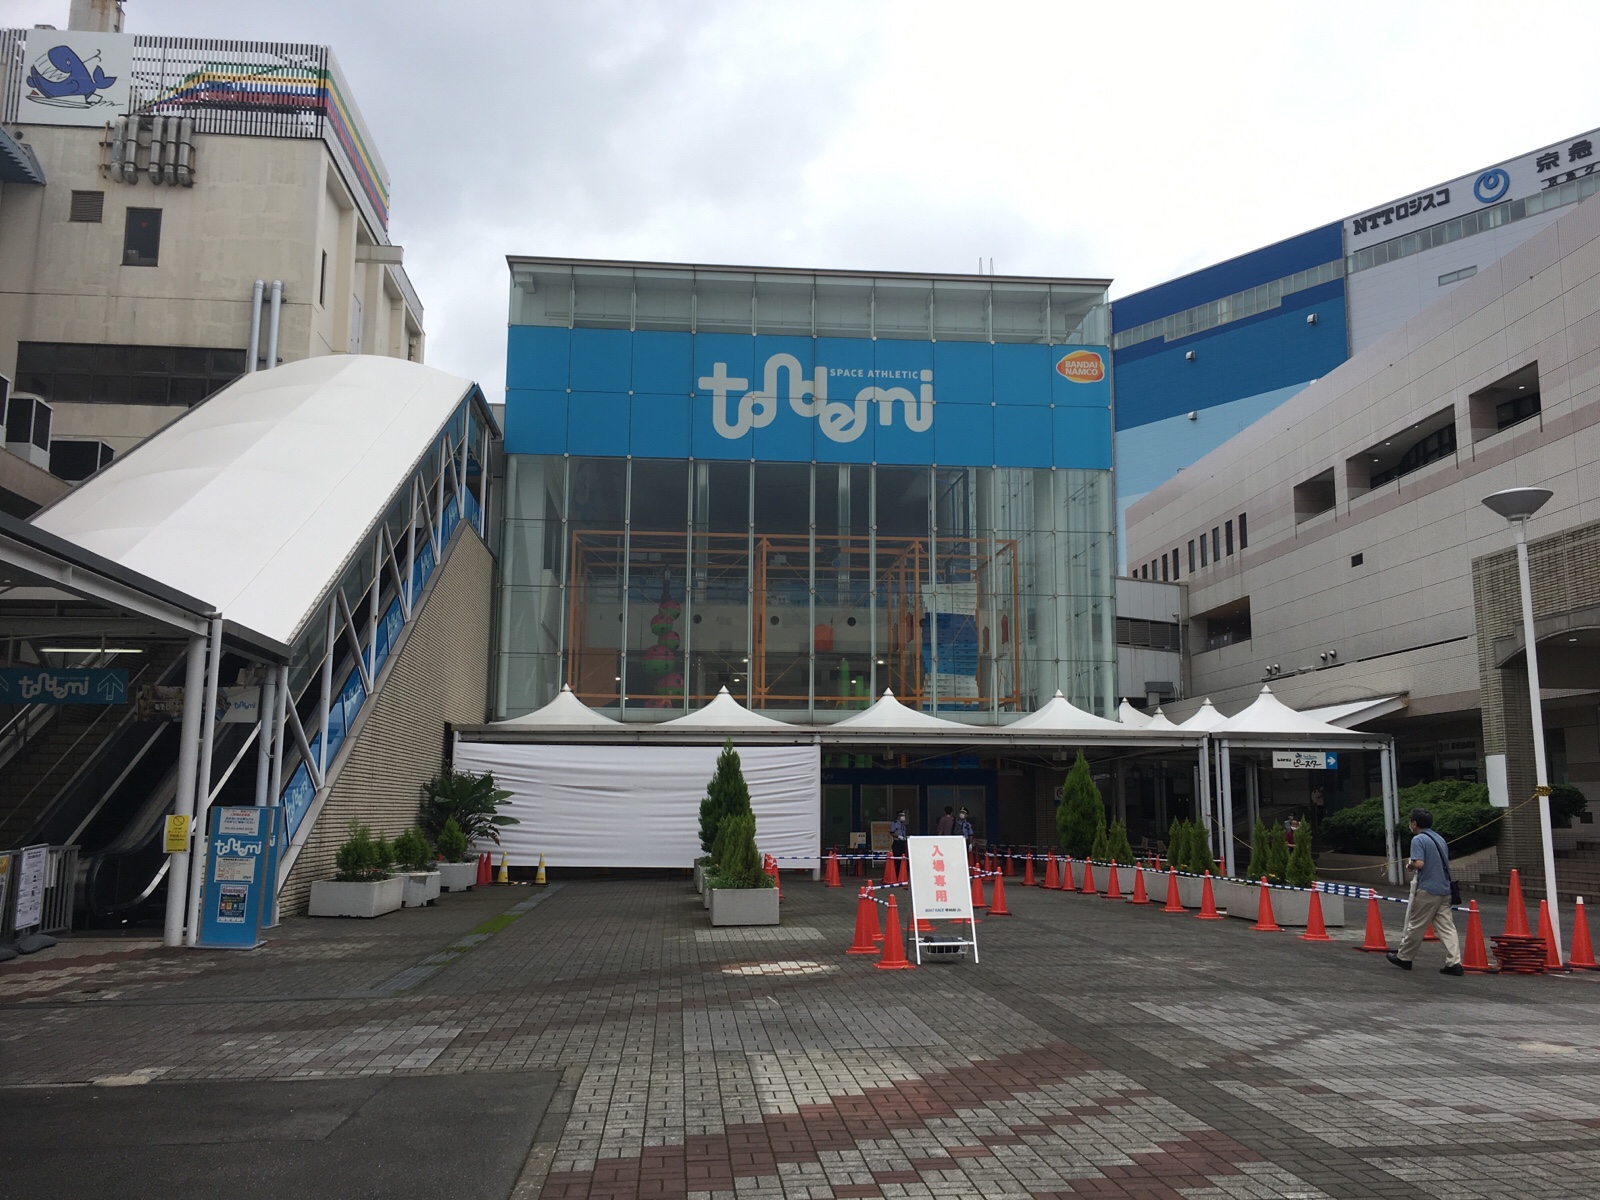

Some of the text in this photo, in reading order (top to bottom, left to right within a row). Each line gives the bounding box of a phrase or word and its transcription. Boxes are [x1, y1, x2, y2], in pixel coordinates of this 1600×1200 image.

[1536, 139, 1593, 173] 京急
[1353, 188, 1450, 236] NTTロジスコ
[830, 368, 919, 379] SPACE ATHLETIC
[1065, 361, 1098, 369] BANDAI
[1065, 368, 1098, 376] NAMCO
[698, 353, 934, 444] tondemi
[18, 672, 90, 699] tondemi
[1294, 759, 1322, 767] ピースター
[215, 838, 262, 857] tondemi
[932, 845, 948, 902] 入場専用
